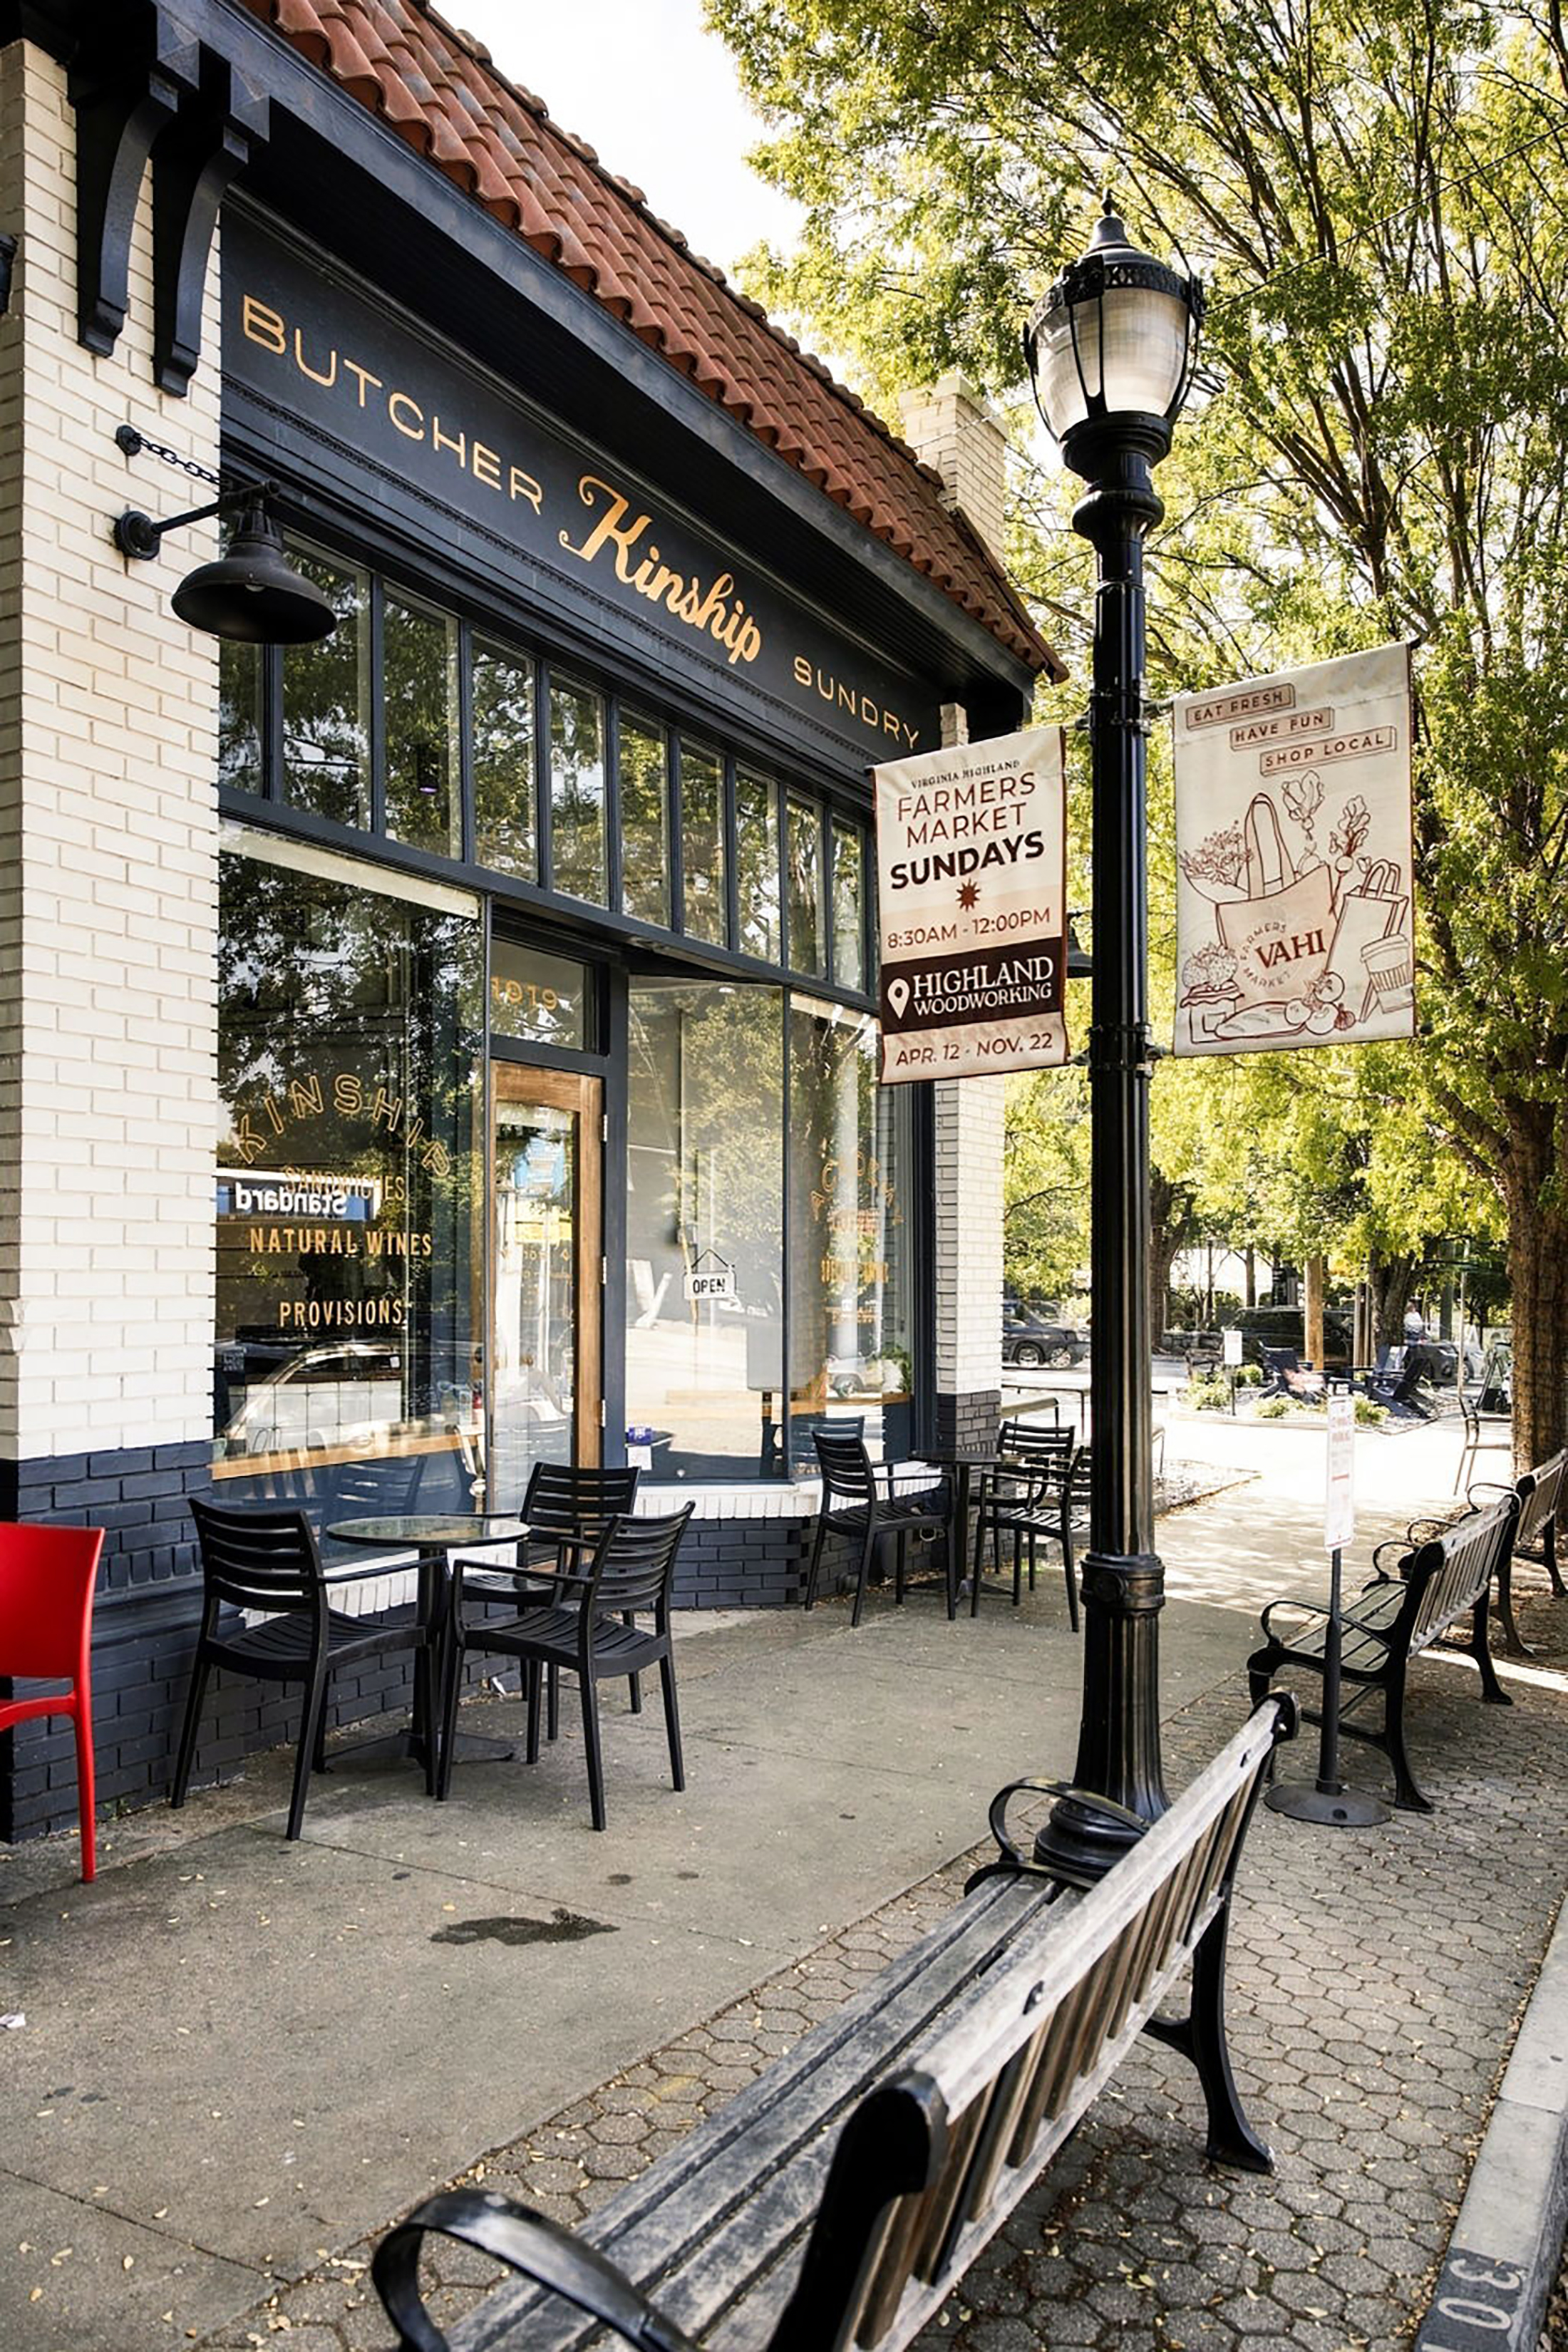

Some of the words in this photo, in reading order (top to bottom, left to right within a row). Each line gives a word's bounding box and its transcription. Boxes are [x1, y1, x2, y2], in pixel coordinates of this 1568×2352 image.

[243, 294, 543, 515] BUTCHER
[559, 475, 762, 664] Kinship
[794, 656, 919, 750] SUNDRY
[1195, 705, 1222, 721] EAT
[1230, 691, 1283, 713] FRESH
[1235, 723, 1279, 742] HAVE
[1289, 713, 1324, 731] FUN
[1265, 748, 1314, 767] SHOP
[1324, 733, 1384, 755] LOCAL
[912, 772, 960, 789] VIRGINIA
[962, 760, 1020, 778] HIGHLAND
[898, 771, 1036, 822] FARMERS
[907, 803, 1028, 848] MARKET
[890, 830, 1045, 889] SUNDAYS
[887, 922, 957, 949] 8:30AM
[972, 907, 1051, 935] 12:00PM
[1255, 929, 1326, 969] VAHI
[913, 956, 1053, 999] HIGHLAND
[914, 982, 1053, 1016] WOODWORKING
[896, 1046, 937, 1066] APR.
[942, 1043, 960, 1061] 12
[977, 1036, 1023, 1058] NOV.
[1030, 1031, 1053, 1051] 22
[234, 1074, 451, 1177] KINSHIP
[250, 1228, 358, 1254] NATURAL
[366, 1230, 432, 1256] WINES
[693, 1279, 726, 1294] OPEN
[279, 1301, 404, 1328] PROVISIONS
